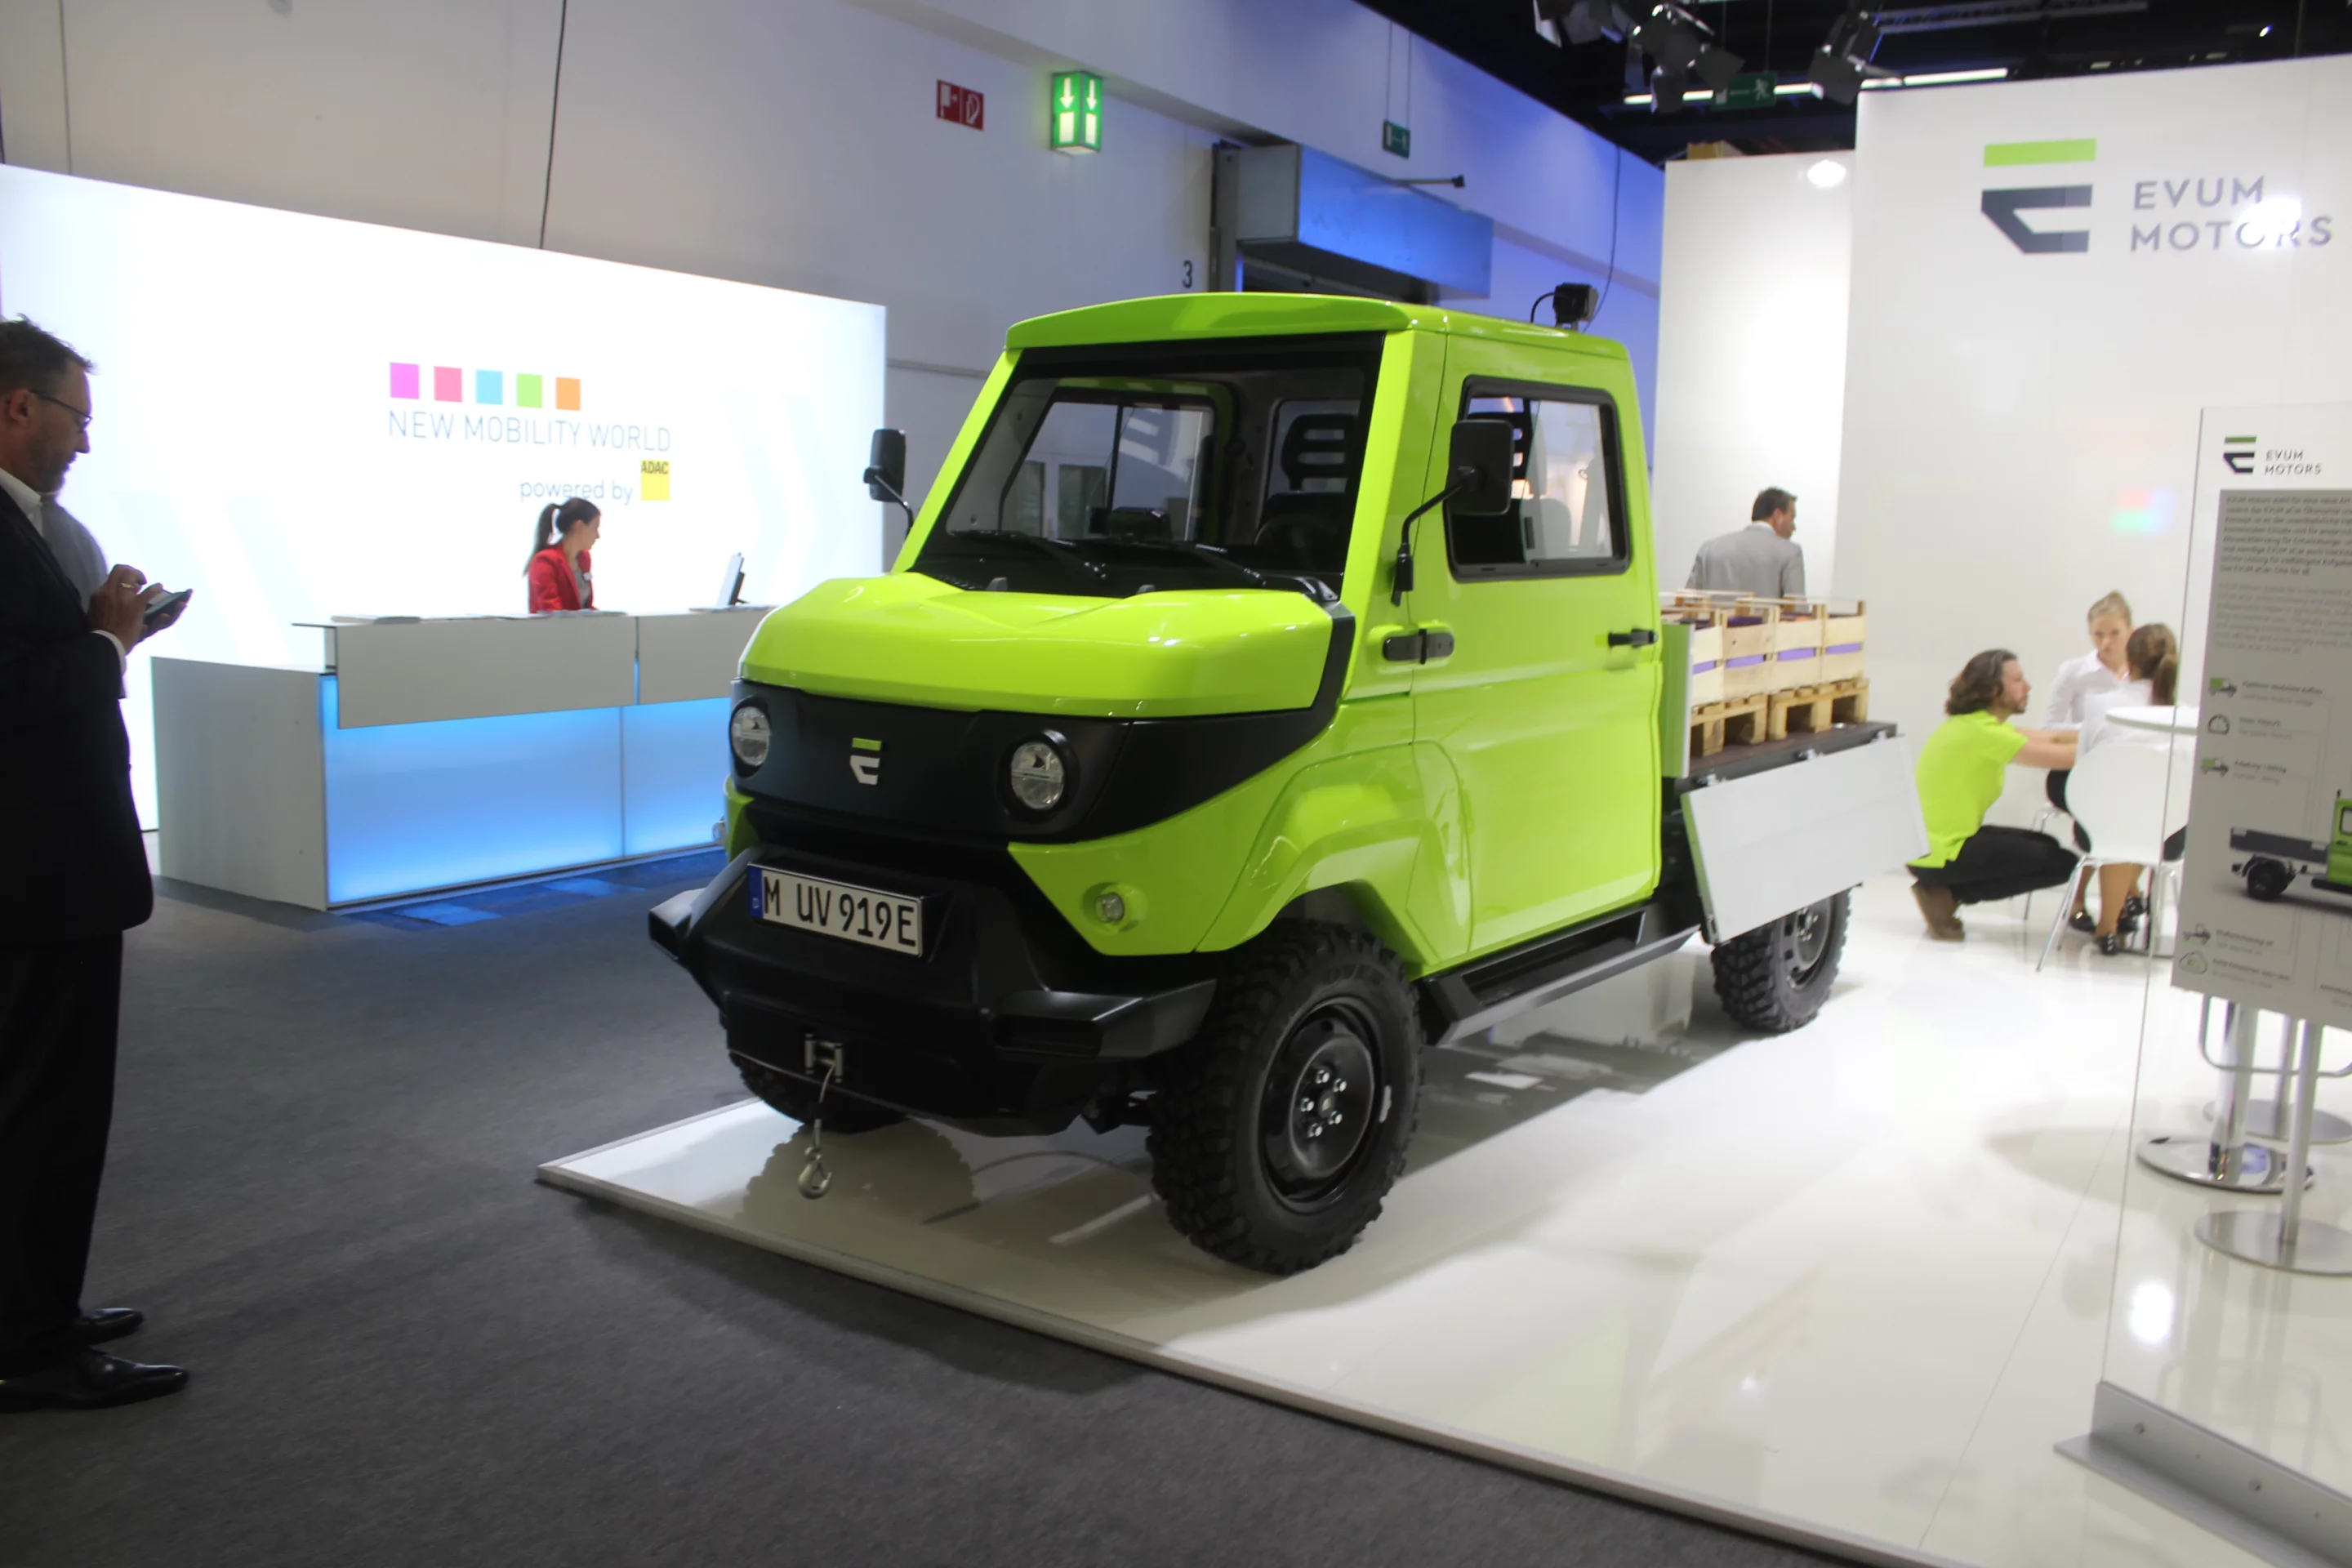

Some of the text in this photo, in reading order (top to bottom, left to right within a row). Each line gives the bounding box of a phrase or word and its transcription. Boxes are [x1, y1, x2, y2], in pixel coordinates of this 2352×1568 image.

[2133, 176, 2265, 211] EVUM
[1183, 260, 1193, 289] 3
[389, 410, 671, 452] NEW MOBILITY WORLD
[641, 460, 670, 474] ADAC
[2265, 449, 2304, 462] EVUM
[2264, 463, 2323, 476] MOTORS
[520, 479, 634, 505] powered by
[764, 876, 916, 947] M UV 919E
